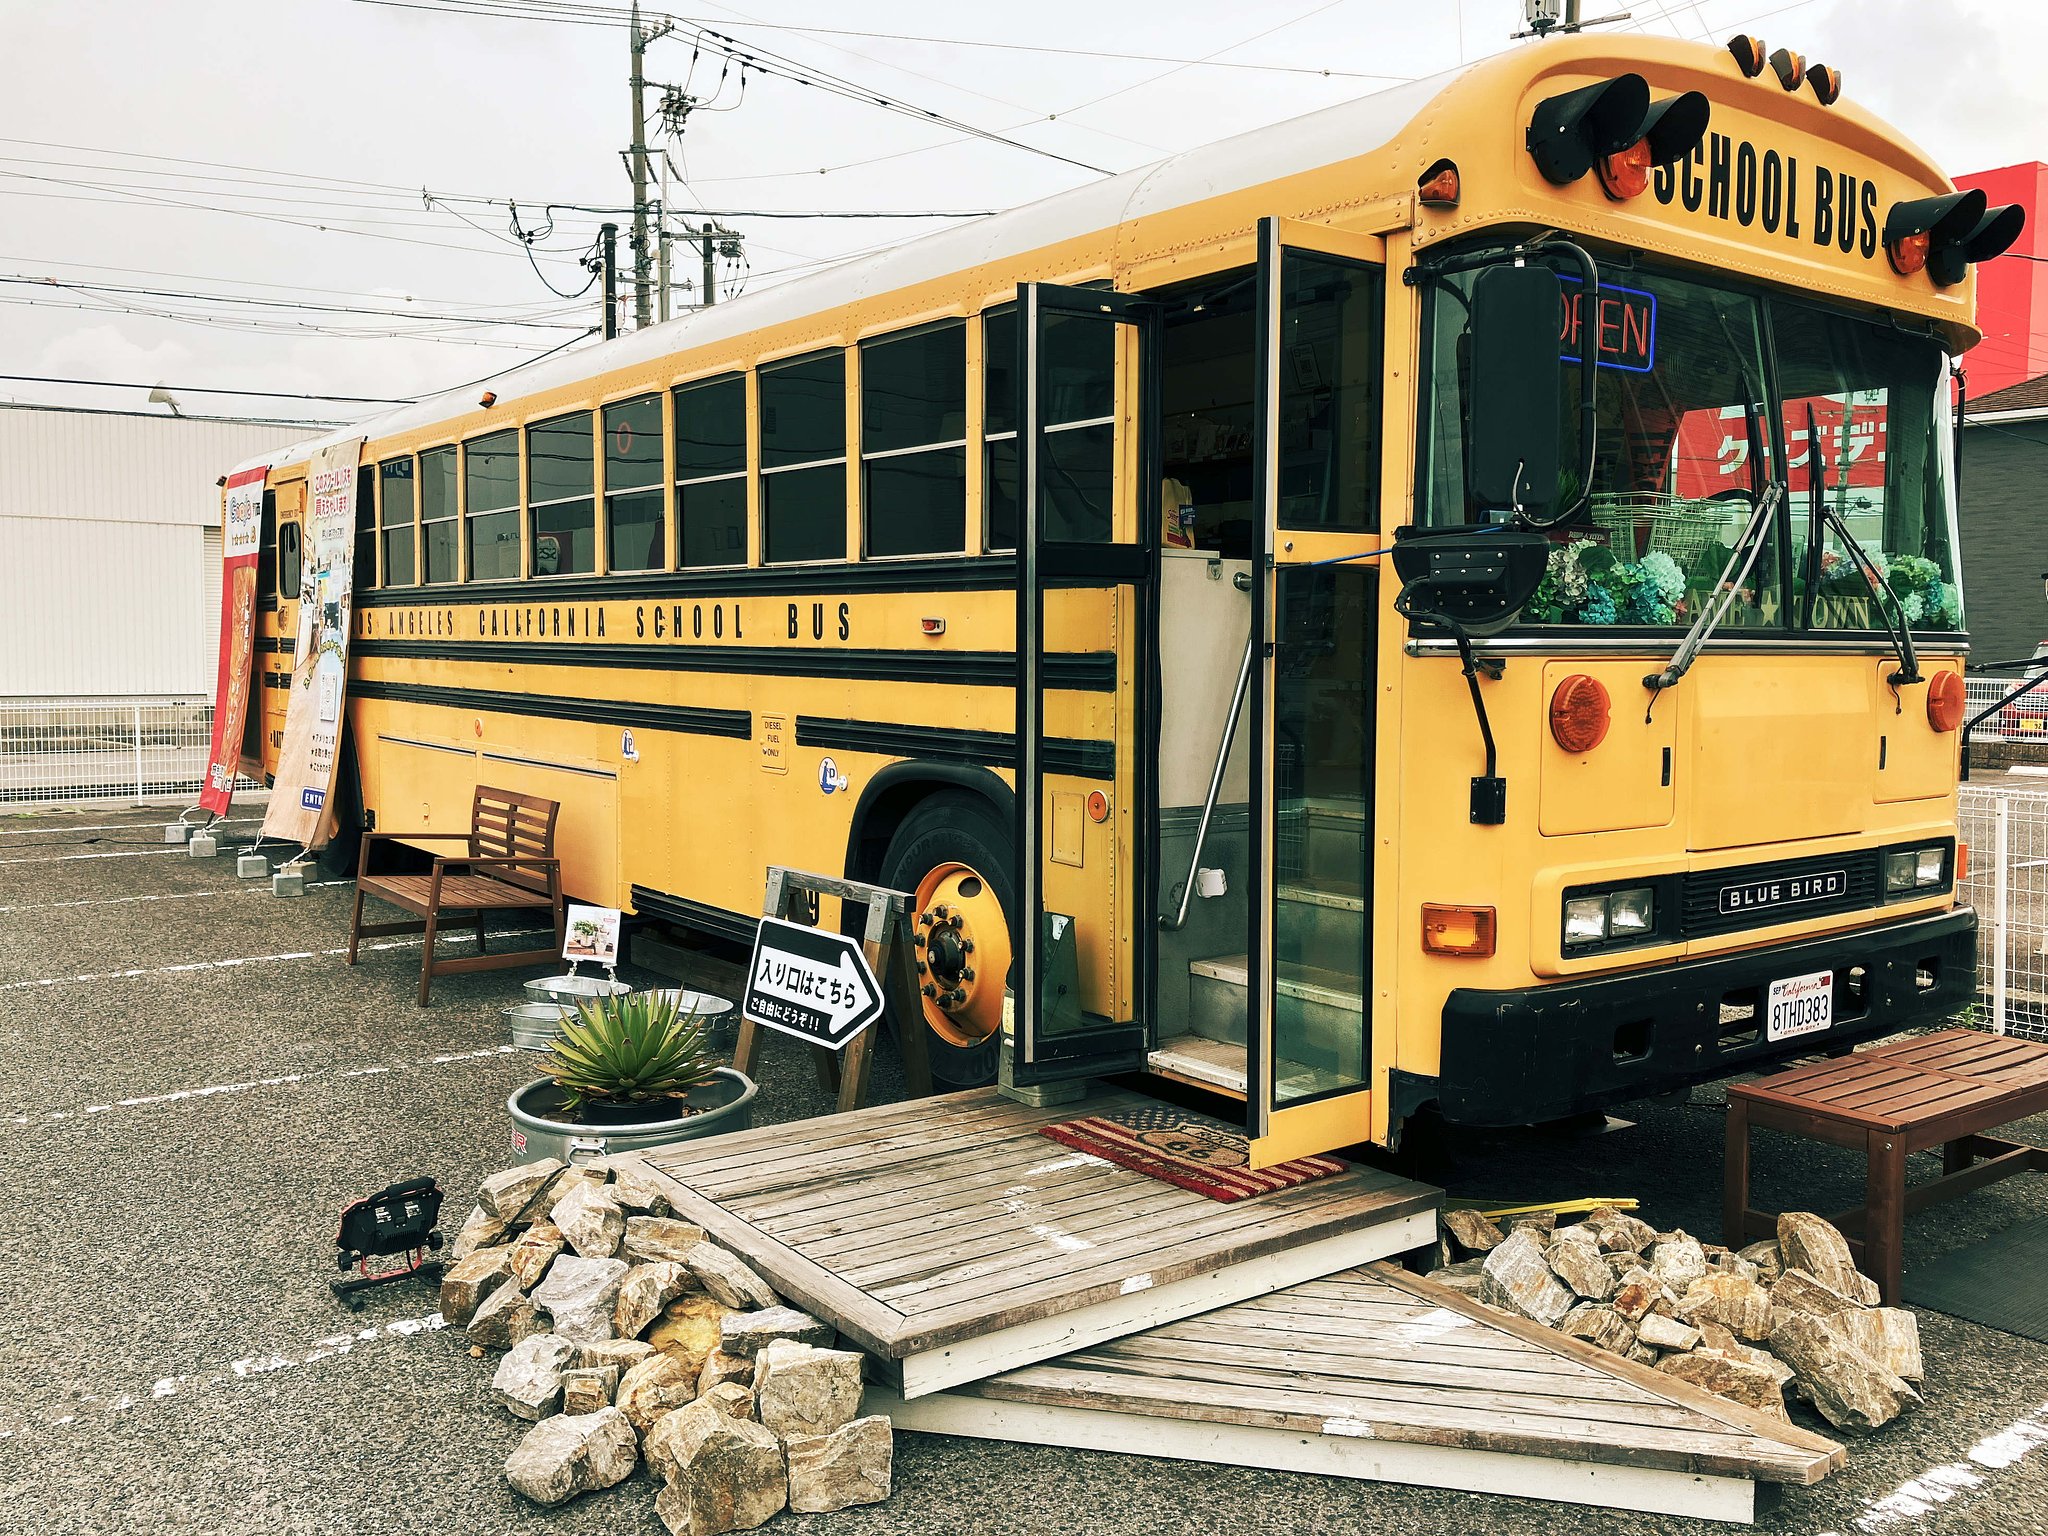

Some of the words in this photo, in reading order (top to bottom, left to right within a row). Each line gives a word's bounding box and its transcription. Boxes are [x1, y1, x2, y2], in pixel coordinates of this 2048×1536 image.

[1813, 165, 1877, 260] BUS
[389, 610, 453, 635] ANGELES
[479, 607, 606, 637] CALIFORNIA
[636, 604, 742, 639] SCHOOL
[787, 602, 850, 641] BUS
[764, 721, 782, 731] DIESEL
[767, 734, 780, 743] FUEL
[767, 748, 780, 757] ONLY
[1730, 885, 1780, 907] BLUE
[1791, 877, 1837, 897] BIRD
[759, 958, 856, 1009] 入り口はこちら
[1781, 981, 1821, 998] California
[1773, 993, 1829, 1031] 8THD383
